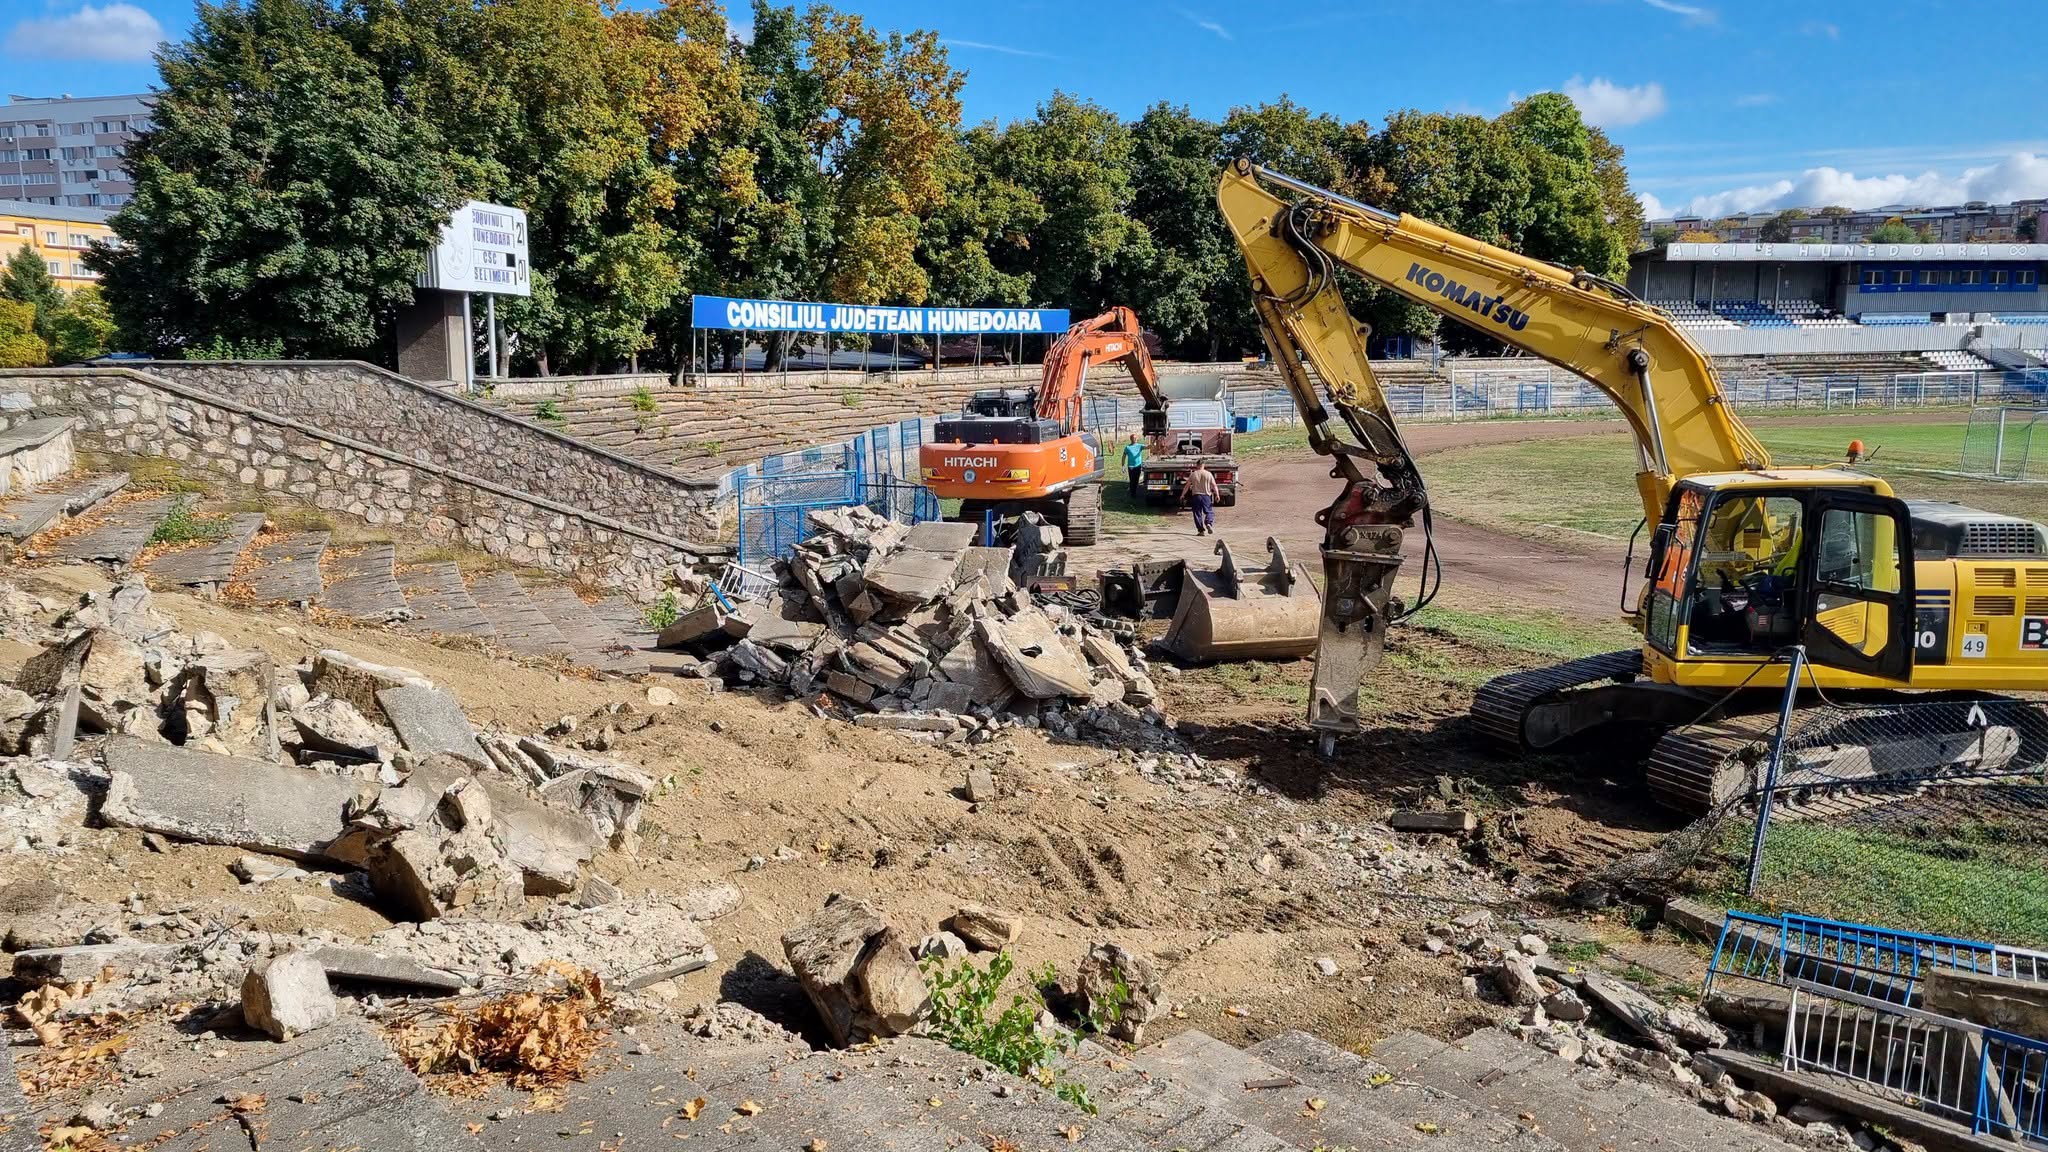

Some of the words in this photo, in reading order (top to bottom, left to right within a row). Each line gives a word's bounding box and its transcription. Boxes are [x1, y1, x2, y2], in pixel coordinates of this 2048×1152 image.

[516, 222, 523, 243] 2
[1673, 244, 1737, 257] AICI
[1799, 245, 1990, 257] HUNEDOARA
[483, 251, 497, 264] CSC
[1405, 262, 1530, 331] KOMATSU
[727, 301, 826, 328] CONSILIUL
[830, 307, 923, 331] JUDETEAN
[928, 310, 1042, 332] HUNEDOARA
[944, 457, 998, 468] HITACHI
[1963, 640, 1985, 652] 49
